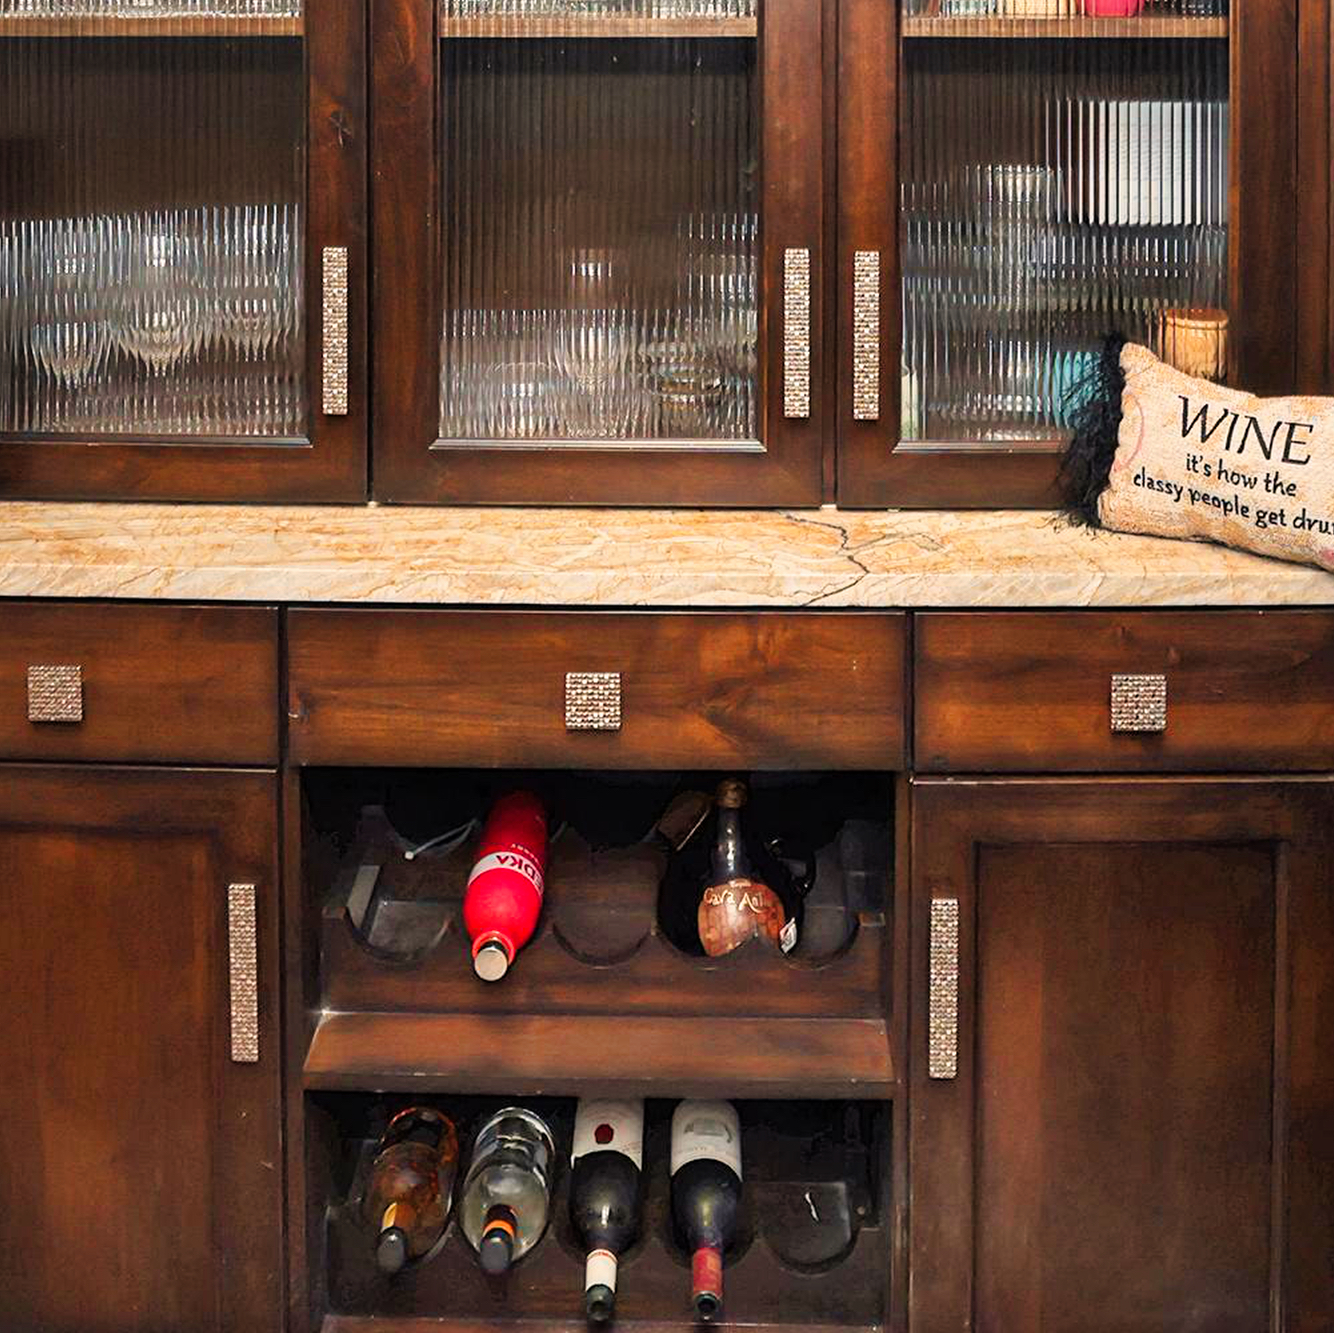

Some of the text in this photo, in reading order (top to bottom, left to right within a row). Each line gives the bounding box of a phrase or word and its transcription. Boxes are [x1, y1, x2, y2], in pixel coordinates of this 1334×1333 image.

[1178, 394, 1314, 466] WINE
[1133, 466, 1184, 503] classy
[1188, 487, 1250, 516] people
[1255, 508, 1287, 529] get
[1186, 452, 1297, 497] it's how the
[703, 886, 736, 907] Cava
